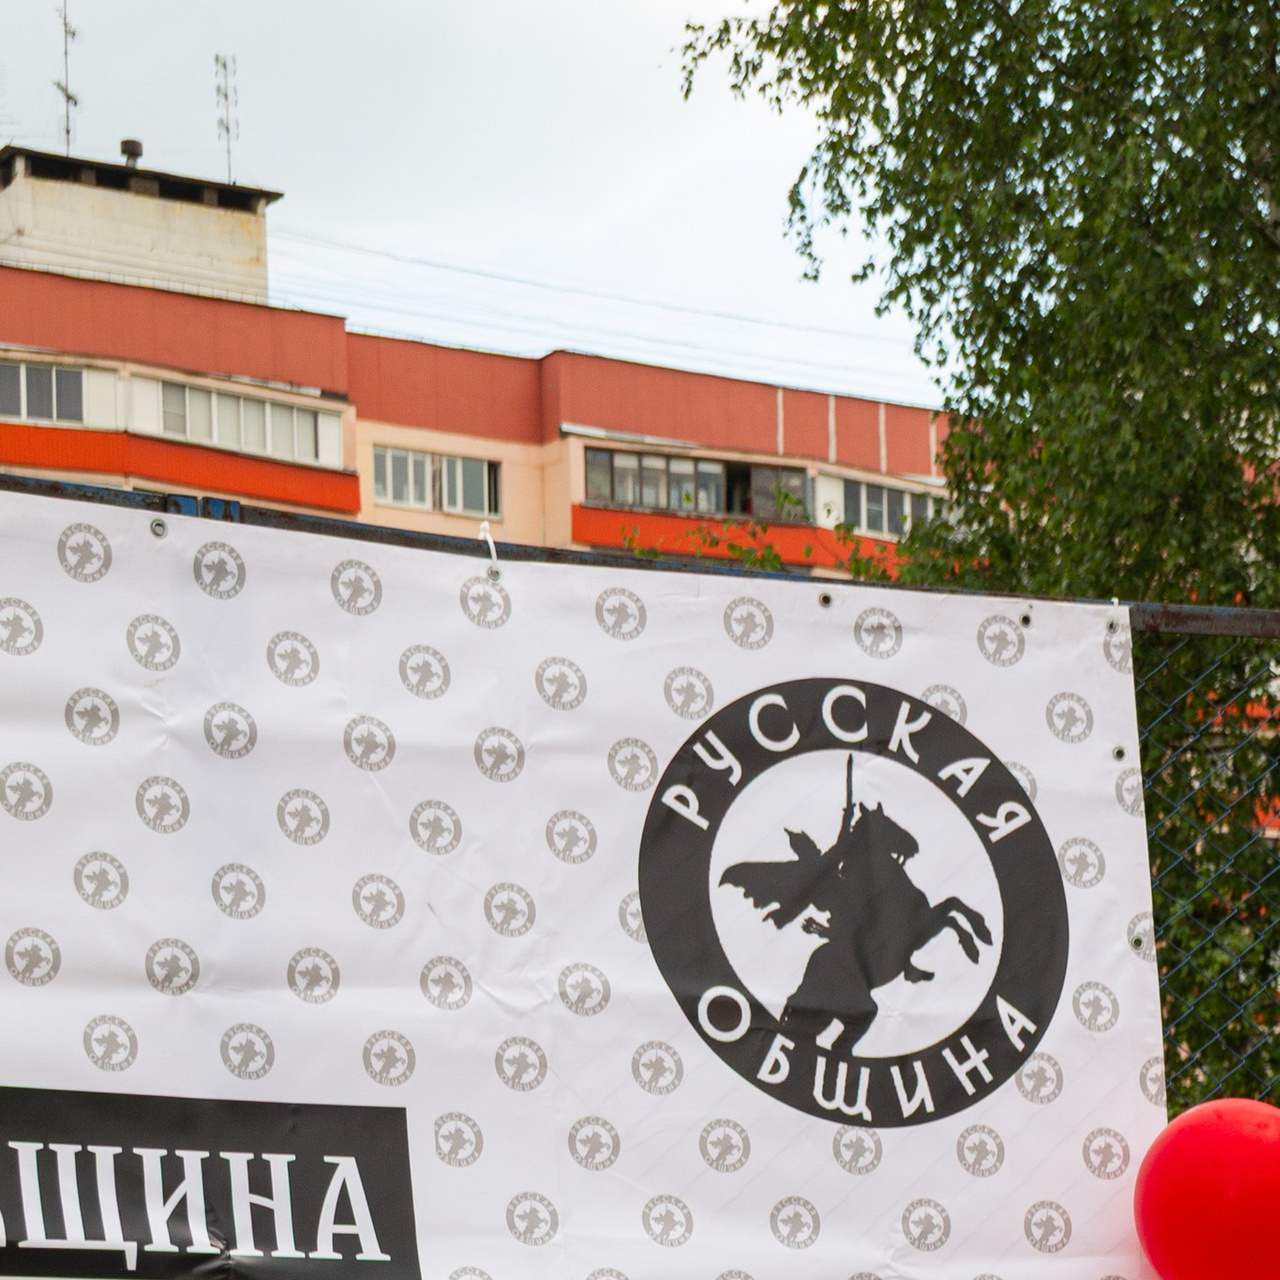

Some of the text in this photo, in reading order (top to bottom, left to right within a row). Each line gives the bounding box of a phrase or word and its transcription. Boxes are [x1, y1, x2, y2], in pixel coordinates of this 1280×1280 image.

[661, 684, 1032, 843] РУССКАЯ
[698, 985, 1038, 1122] ОБЩИНА
[0, 1141, 391, 1271] ЩИНА
